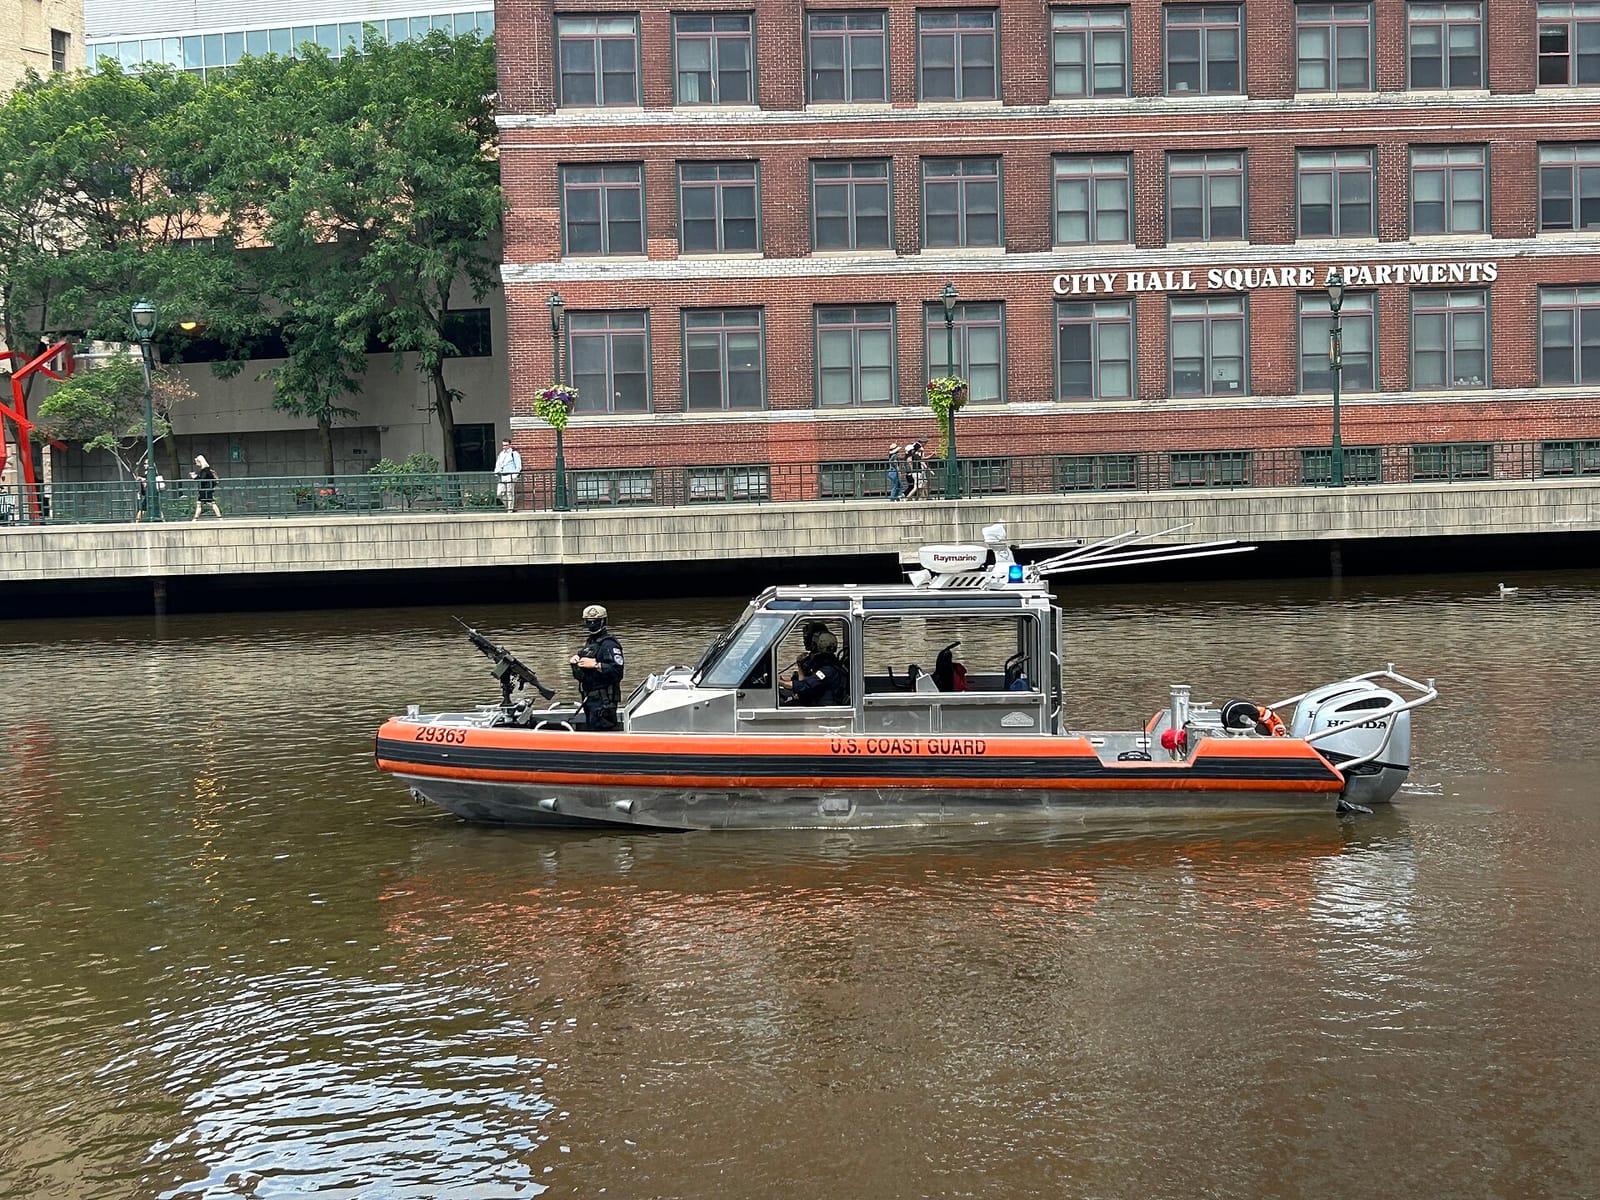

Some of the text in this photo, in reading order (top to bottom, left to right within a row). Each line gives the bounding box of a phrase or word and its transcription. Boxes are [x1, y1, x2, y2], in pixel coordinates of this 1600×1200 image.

[1053, 262, 1498, 294] CITY HALL SQUARE APARTMENTS
[933, 554, 977, 563] Raymarine
[416, 726, 467, 744] 29363
[831, 738, 986, 755] U.S. COAST GUARD
